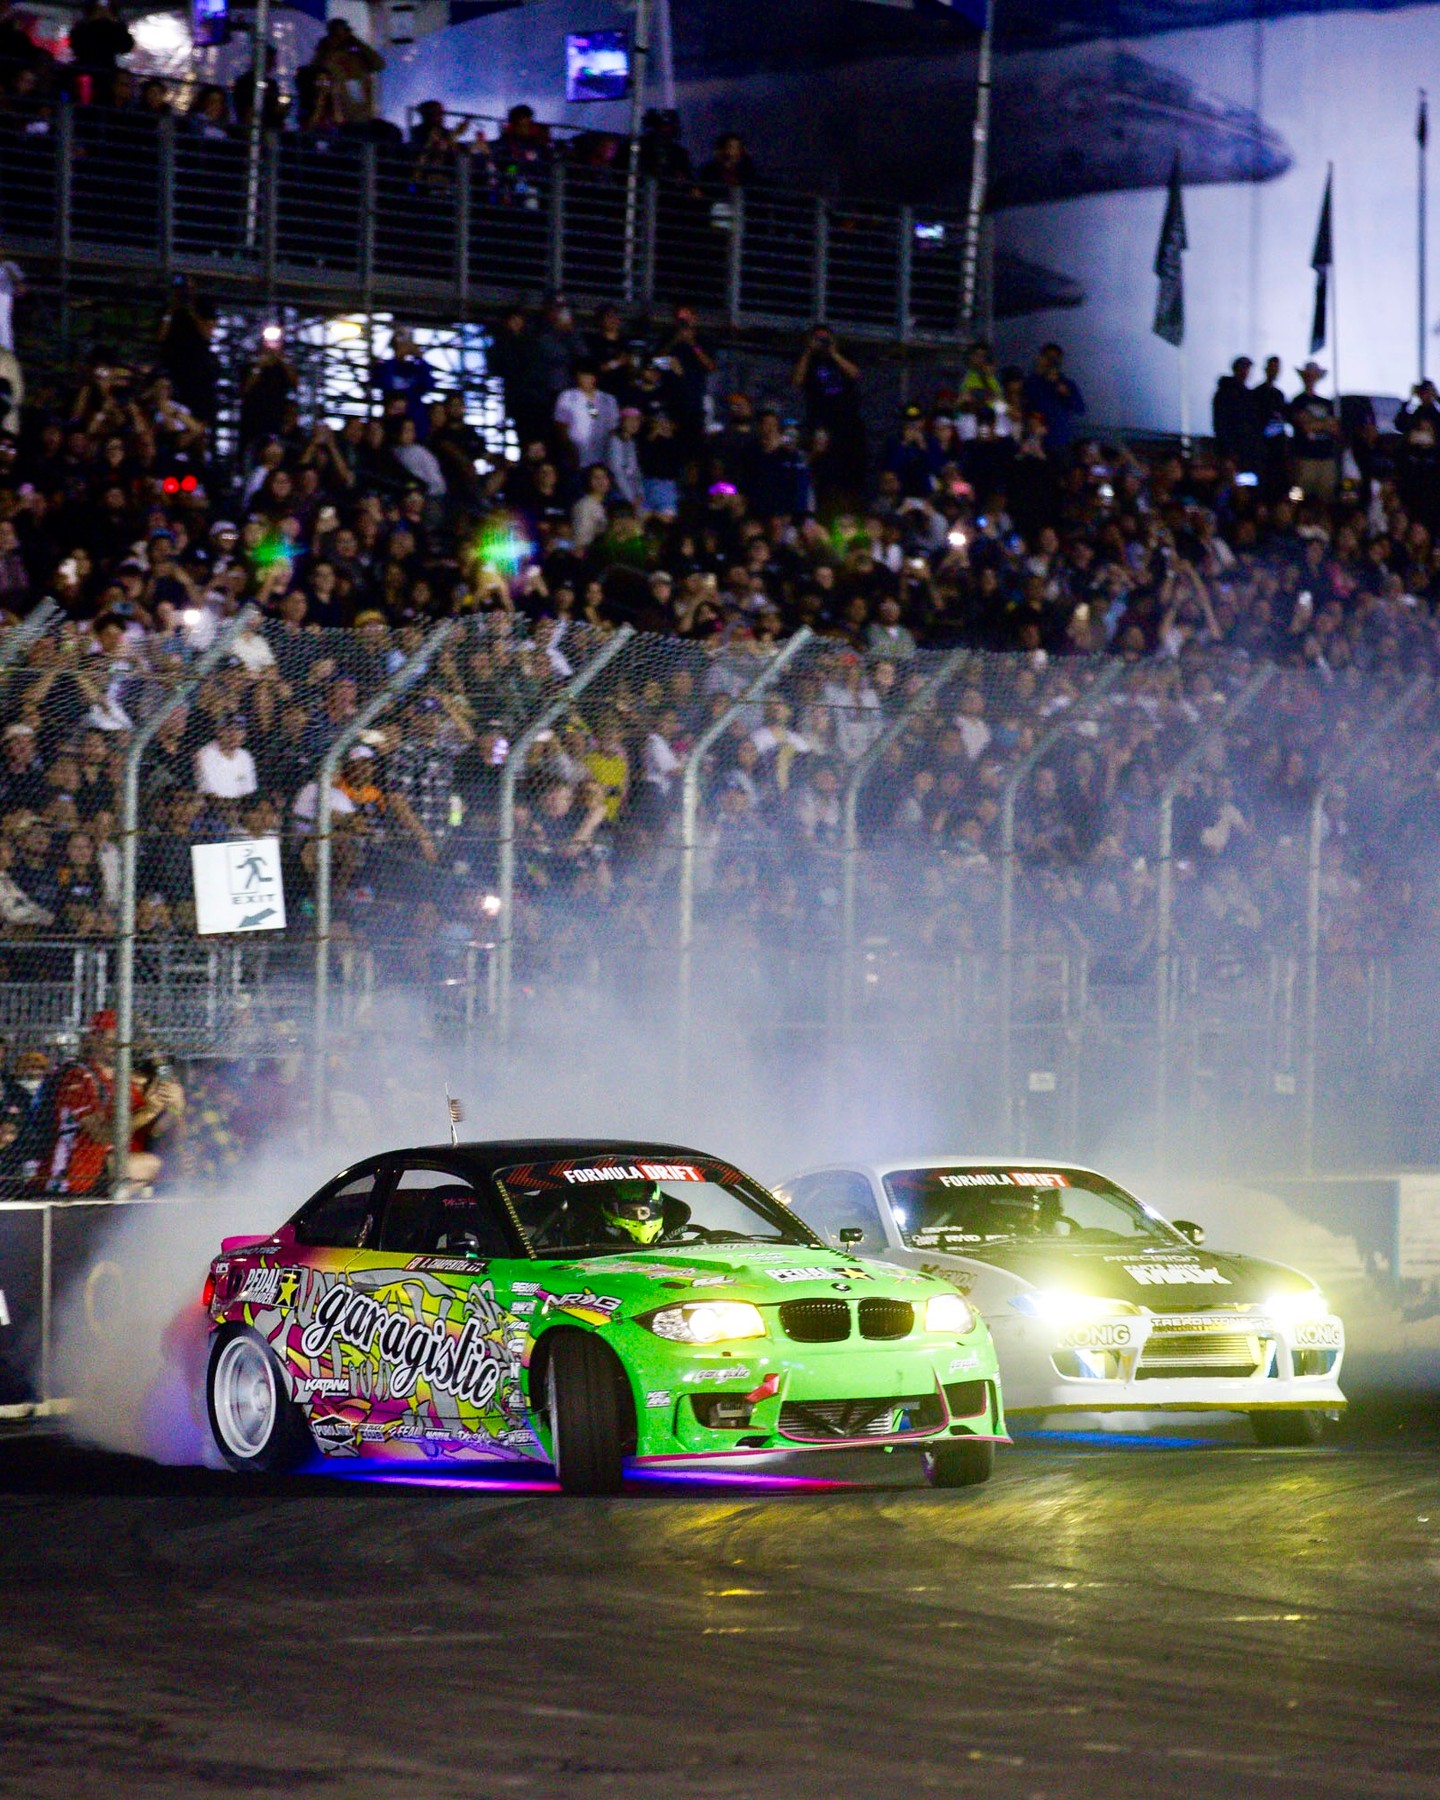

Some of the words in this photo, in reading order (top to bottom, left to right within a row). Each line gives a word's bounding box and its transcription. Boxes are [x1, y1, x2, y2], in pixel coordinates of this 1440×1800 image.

[232, 894, 275, 905] EXIT
[563, 1166, 645, 1184] FORMULA
[641, 1165, 700, 1181] DRIFT
[939, 1174, 1014, 1187] FORMULA
[1011, 1172, 1067, 1187] DRIFT
[242, 1268, 281, 1293] PEDAL
[1128, 1267, 1232, 1285] MAX
[1294, 1322, 1341, 1346] KONIG
[302, 1282, 500, 1408] garagistic
[304, 1378, 349, 1399] KATANA
